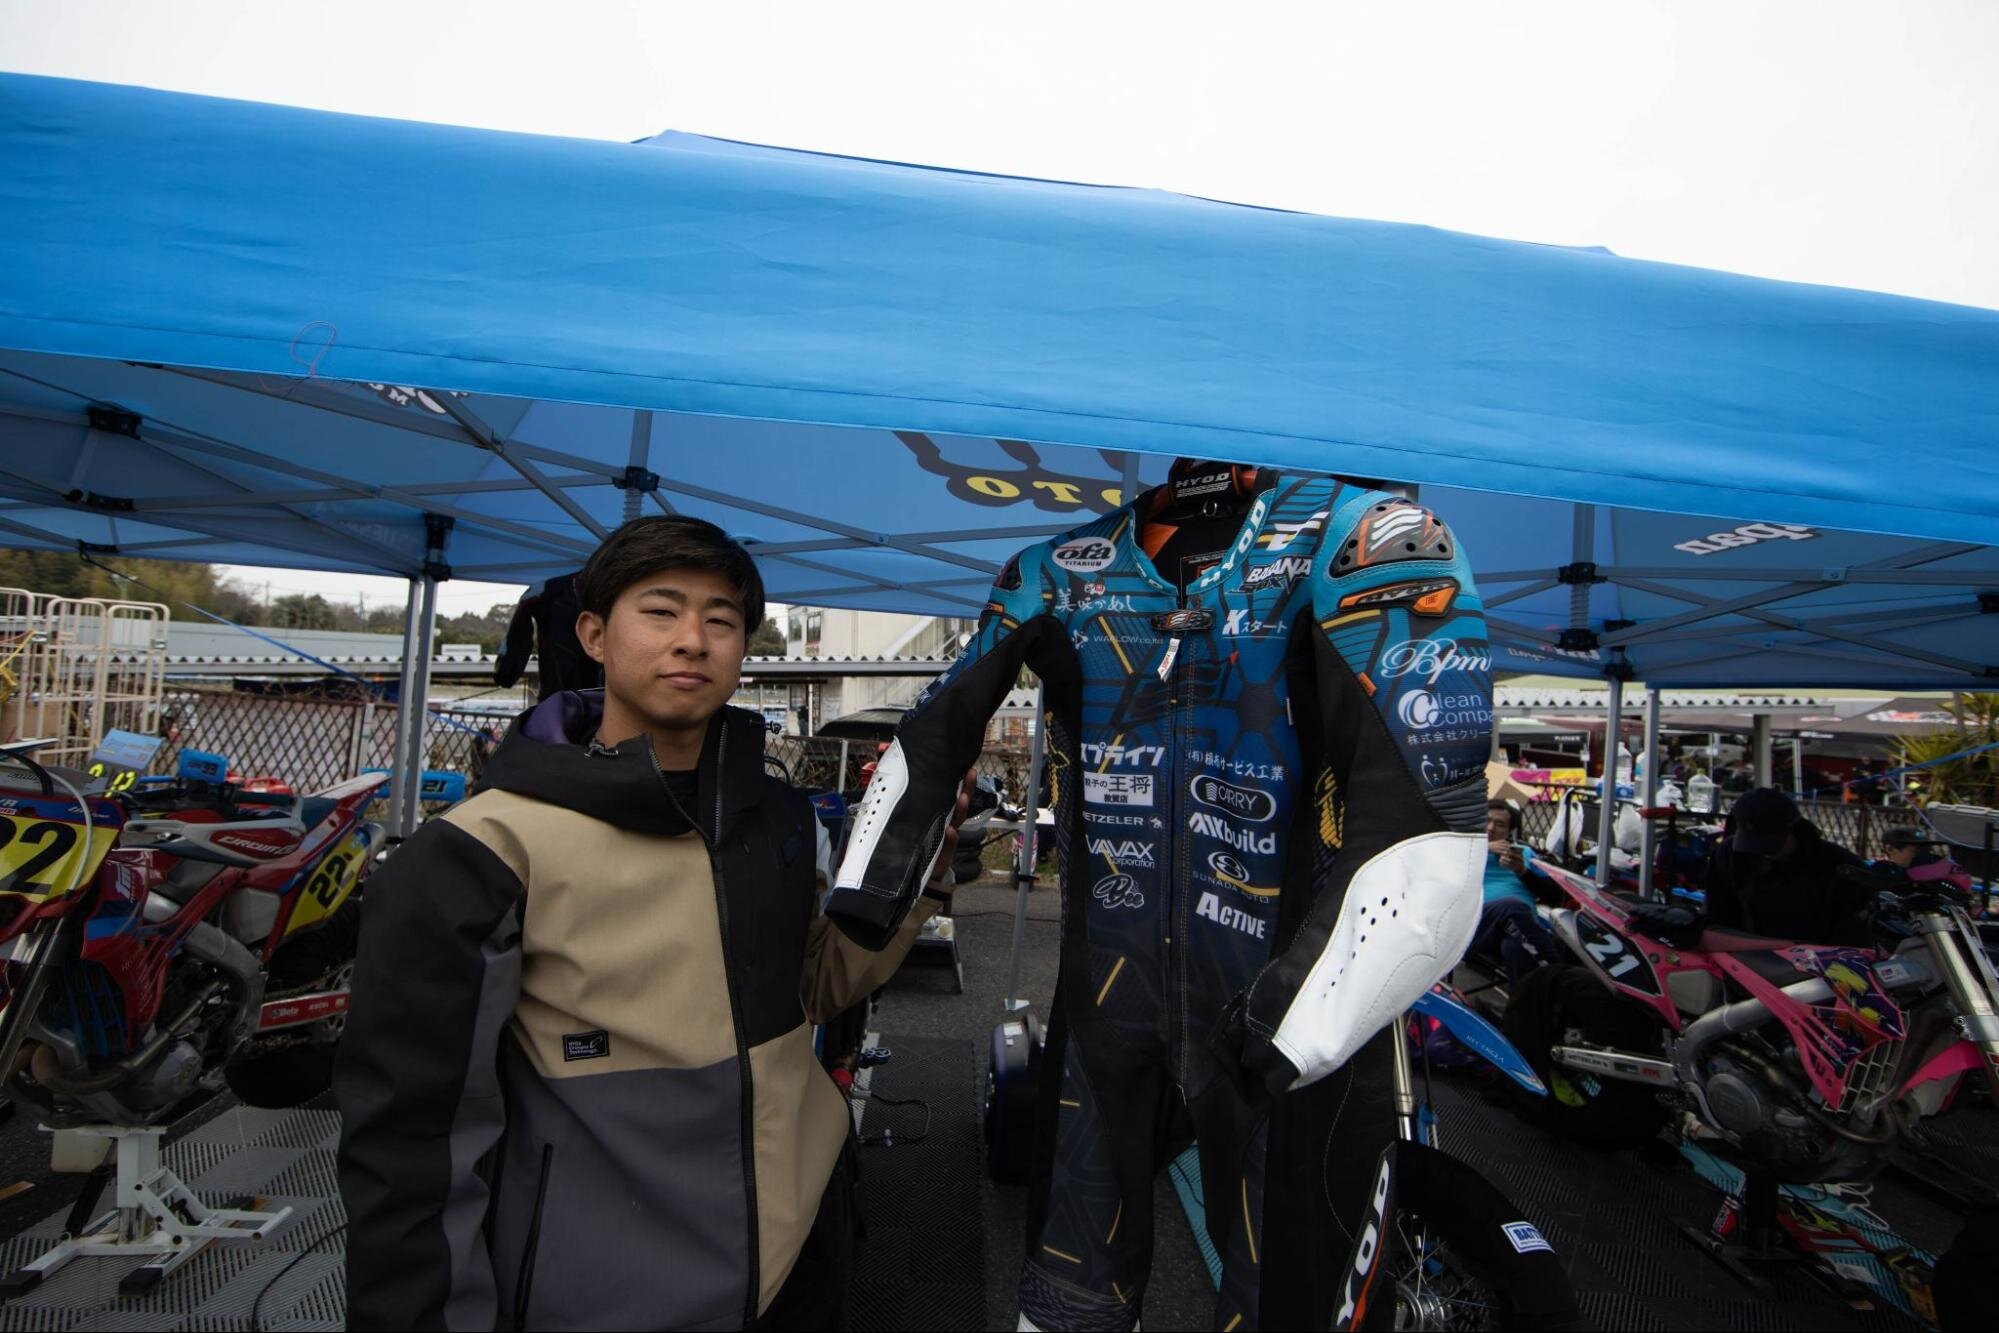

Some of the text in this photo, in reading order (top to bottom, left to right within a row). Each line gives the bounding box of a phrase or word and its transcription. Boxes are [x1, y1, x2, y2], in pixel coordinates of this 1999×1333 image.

[1176, 473, 1231, 488] HYOD
[1056, 542, 1112, 560] ofa
[1200, 499, 1266, 587] HYOD
[1381, 638, 1493, 685] Bpm
[1082, 811, 1144, 826] ETZELER
[1085, 833, 1155, 861] VAVAX
[309, 855, 348, 909] 22
[1195, 891, 1266, 939] ACTIVE
[1585, 933, 1640, 978] 21
